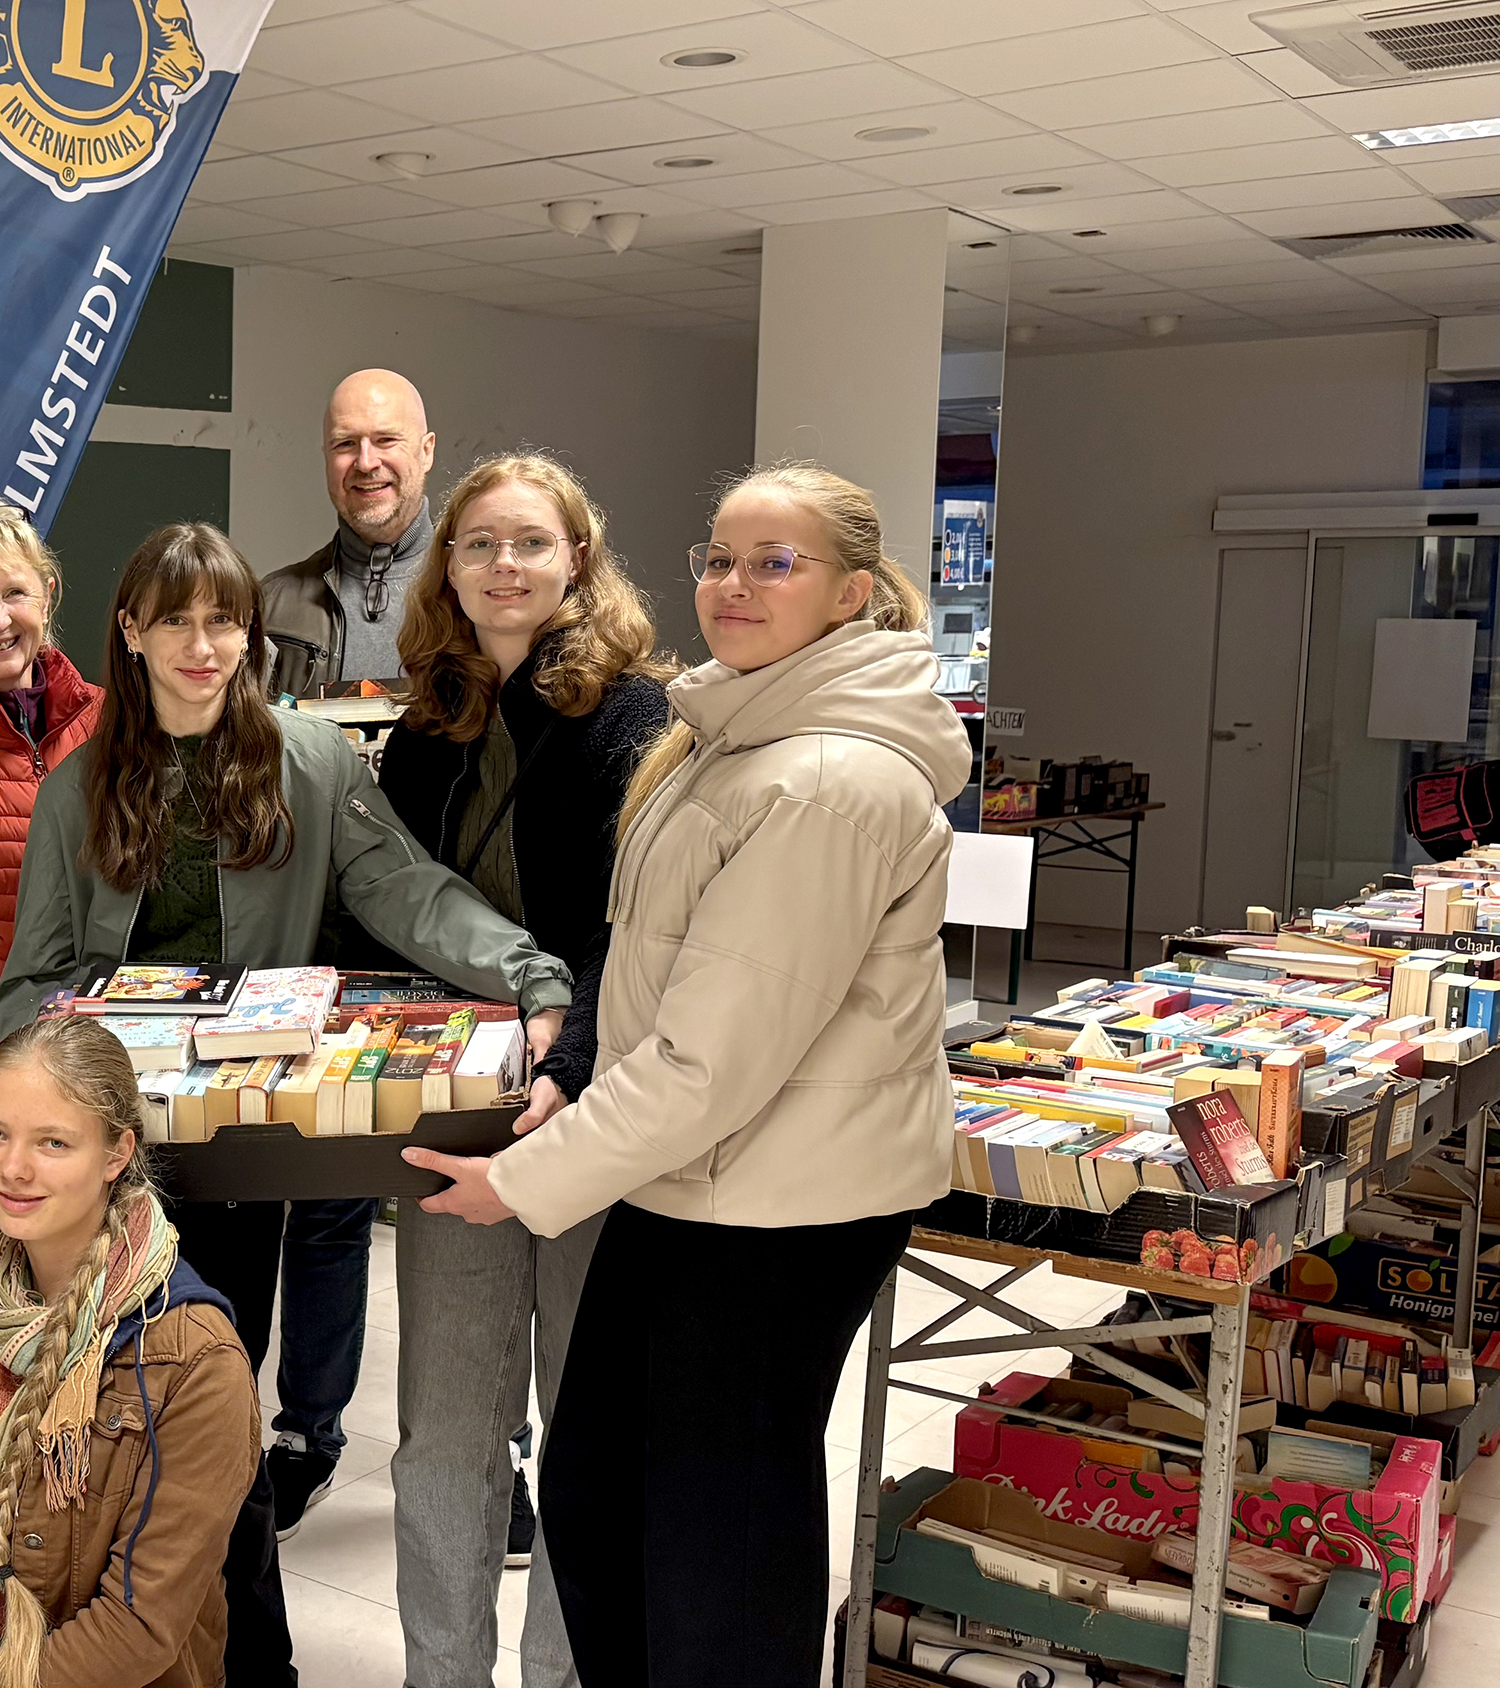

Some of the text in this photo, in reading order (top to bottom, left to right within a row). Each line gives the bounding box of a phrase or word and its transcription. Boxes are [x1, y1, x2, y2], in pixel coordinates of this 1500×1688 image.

[0, 97, 145, 167] INTERNATIONAL
[4, 244, 133, 513] LMSTEDT
[987, 710, 1024, 729] ACHTEN
[1196, 1097, 1227, 1121] nora
[1209, 1117, 1250, 1146] roberts
[1234, 1154, 1268, 1177] Sturms
